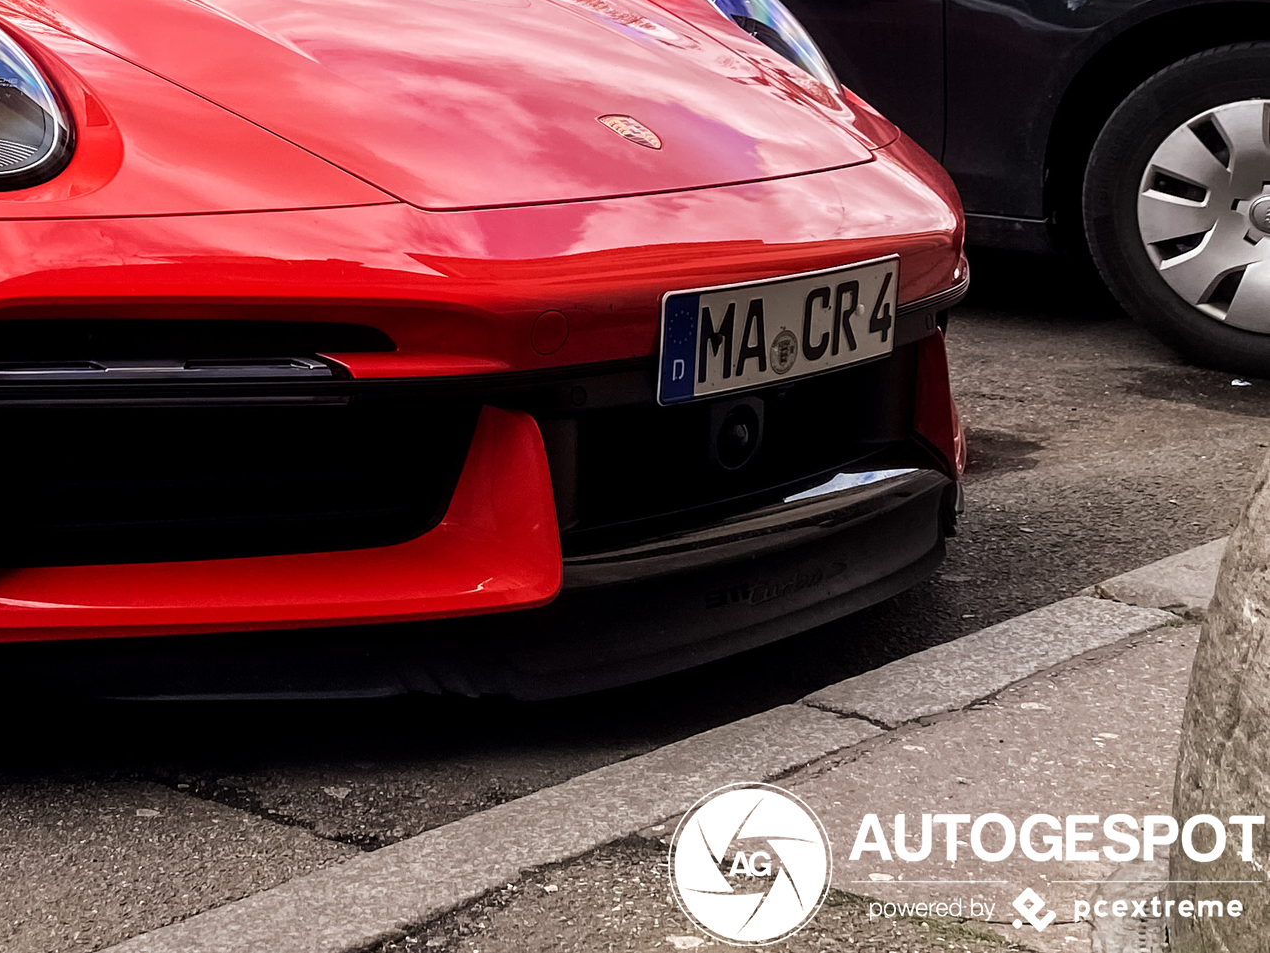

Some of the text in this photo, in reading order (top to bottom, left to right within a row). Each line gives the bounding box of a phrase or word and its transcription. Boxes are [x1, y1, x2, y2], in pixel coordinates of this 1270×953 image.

[698, 298, 767, 383] MA
[802, 280, 859, 361] CR
[869, 272, 893, 342] 4
[672, 359, 685, 381] D
